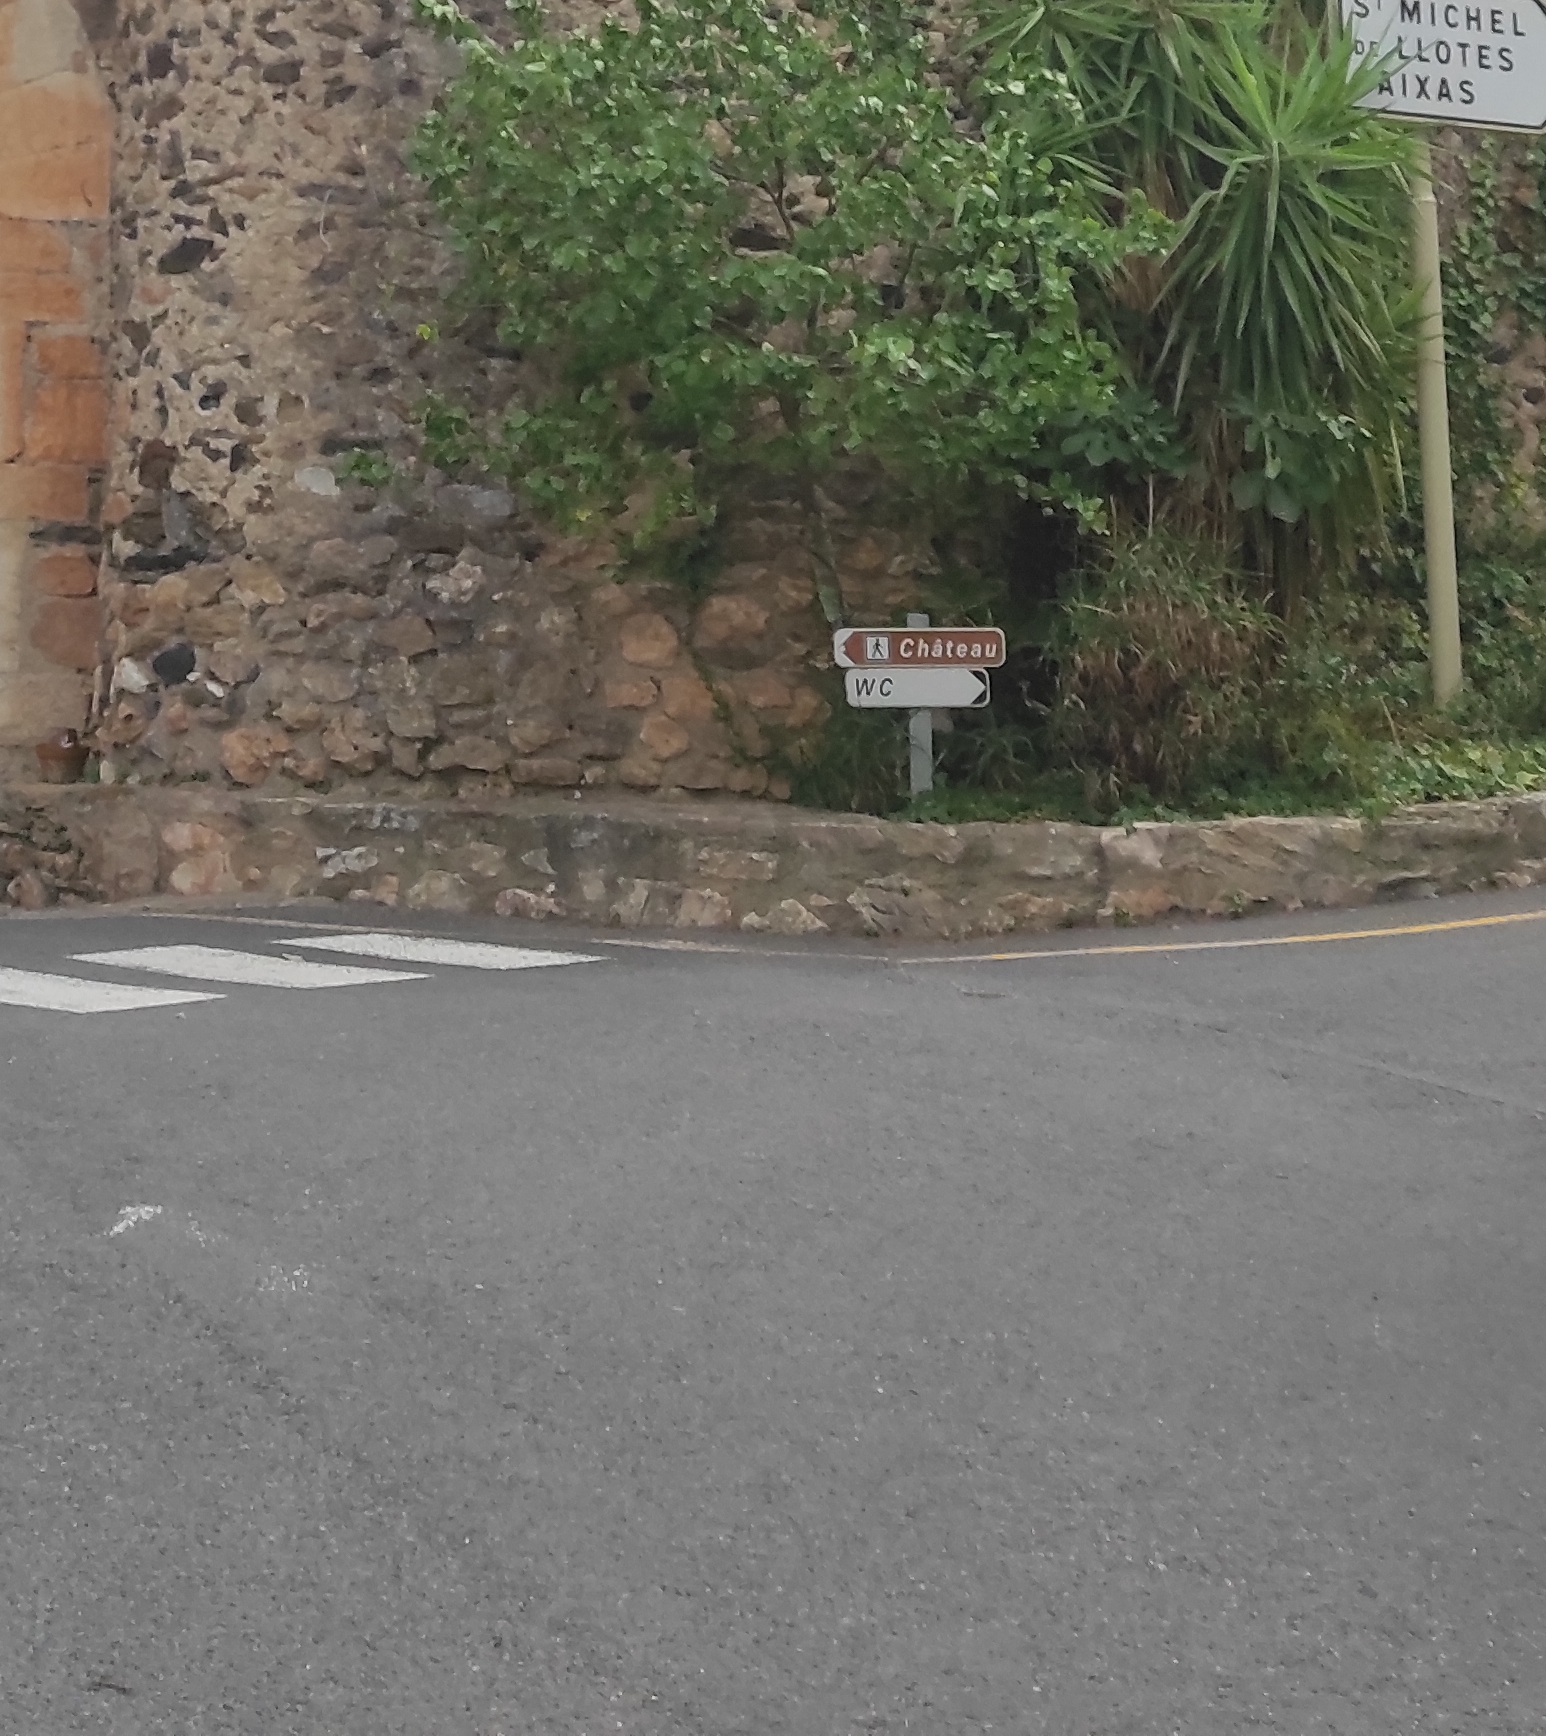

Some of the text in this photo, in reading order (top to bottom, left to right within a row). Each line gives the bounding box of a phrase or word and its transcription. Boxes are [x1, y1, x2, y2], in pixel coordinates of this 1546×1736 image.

[1400, 0, 1527, 37] MICHEL
[1397, 35, 1515, 73] LLOTES
[1377, 70, 1476, 105] AIXAS
[899, 638, 997, 659] Château
[855, 678, 894, 697] WC
